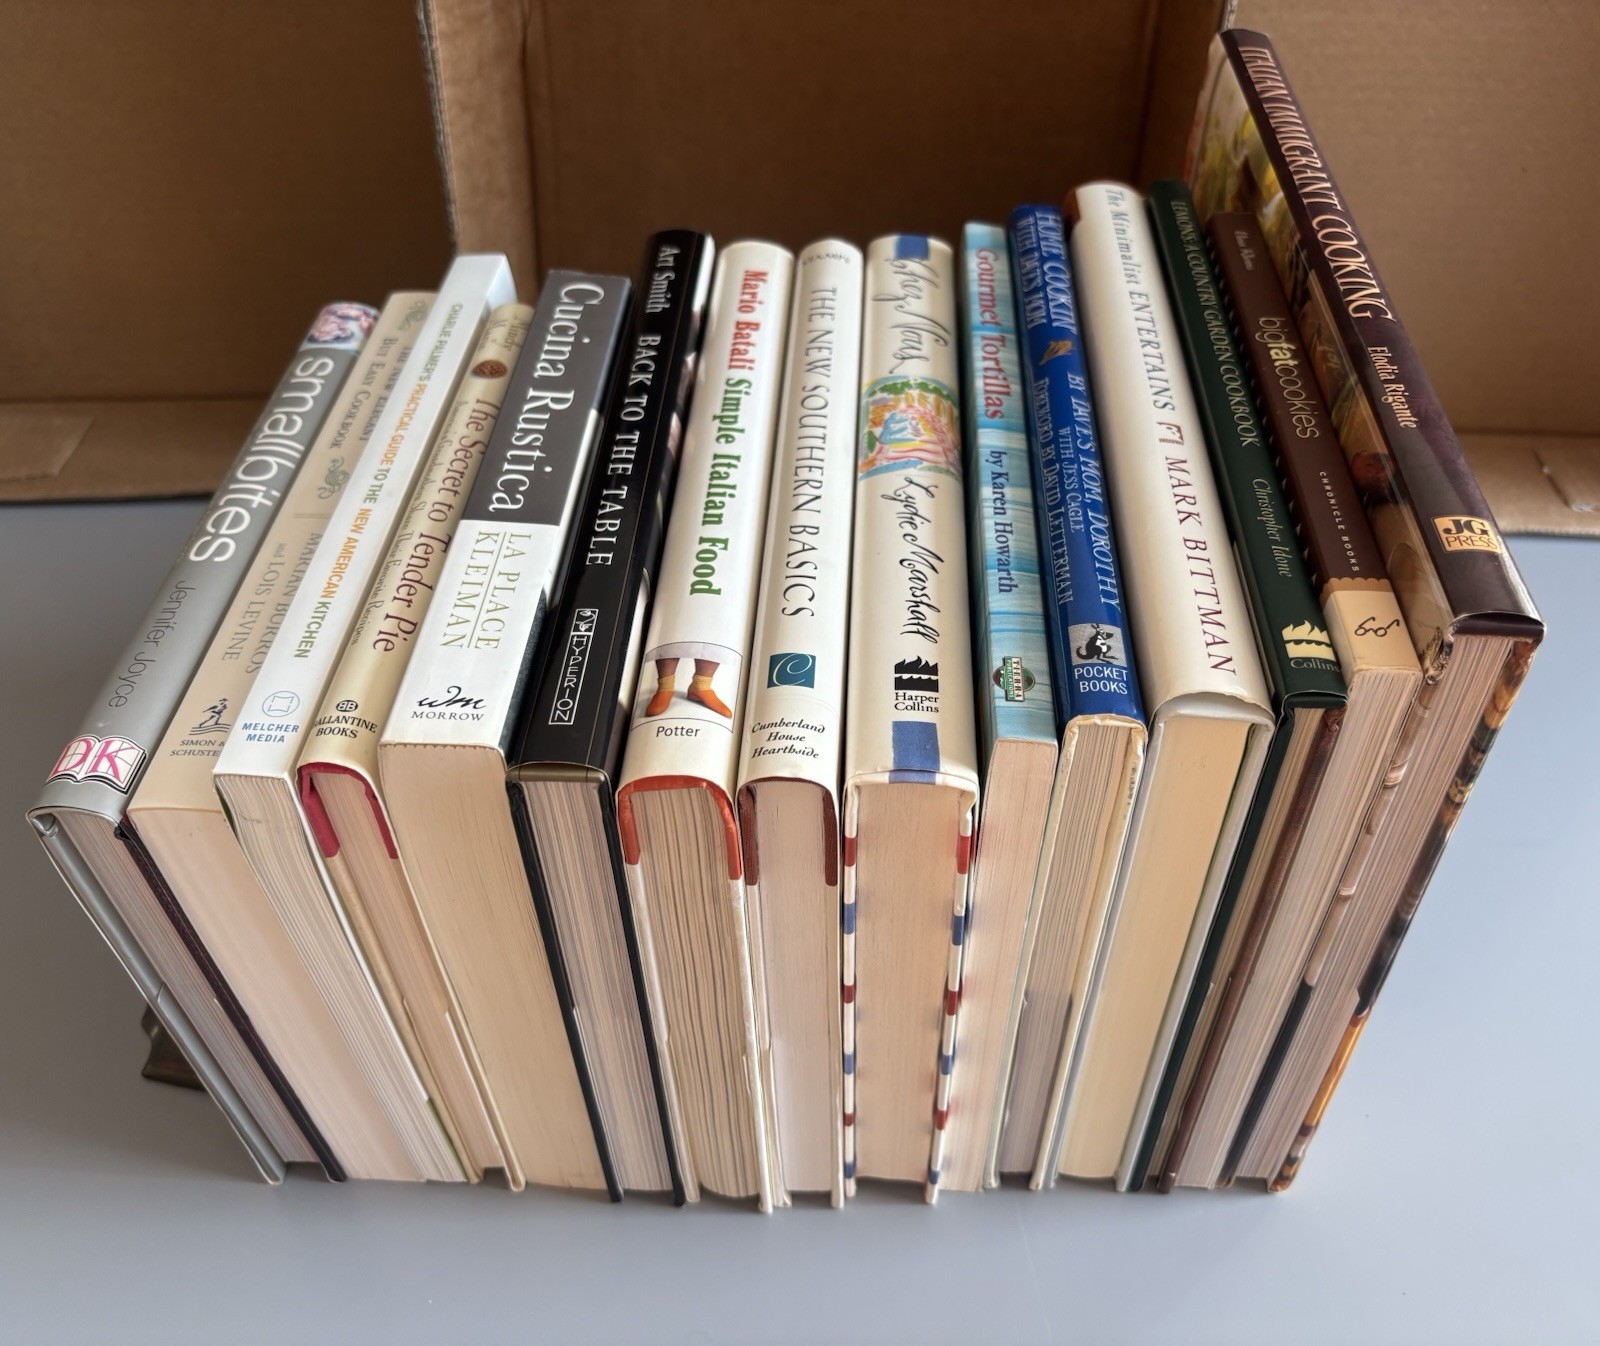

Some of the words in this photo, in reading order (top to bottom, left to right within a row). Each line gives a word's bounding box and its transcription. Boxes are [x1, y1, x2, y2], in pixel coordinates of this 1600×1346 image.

[1106, 188, 1125, 208] The
[656, 244, 681, 269] Art
[1035, 211, 1064, 259] HOME
[1110, 210, 1142, 286] Minimalist
[976, 247, 1001, 327] Gourmet
[1312, 214, 1397, 323] COOKING
[645, 271, 676, 314] Smith
[737, 269, 768, 314] Mario
[808, 287, 837, 321] THE
[439, 303, 464, 339] CHARLIE
[533, 283, 605, 379] Cucina
[419, 339, 448, 382] PALMER'S
[629, 334, 662, 387] BACK
[727, 320, 761, 371] Batali
[804, 330, 833, 378] NEW
[1128, 289, 1176, 411] ENTERTAINS
[1186, 251, 1217, 306] COUNTRY
[1204, 308, 1235, 364] GARDEN
[1220, 365, 1260, 447] COOKBOOK
[1367, 346, 1400, 381] Elodia
[980, 334, 1011, 419] Tortillas
[1067, 372, 1086, 395] BY
[1254, 317, 1319, 439] bigfatcookies
[395, 383, 428, 436] PRACTICAL
[466, 398, 501, 432] The
[620, 394, 648, 421] TO
[712, 377, 753, 445] Simple
[1381, 383, 1418, 430] Rigante
[188, 356, 335, 562] smallbites
[380, 435, 405, 466] GUIDE
[489, 387, 575, 512] Rustica
[607, 431, 639, 476] THE
[791, 385, 830, 512] SOUTHERN
[986, 450, 1008, 468] by
[1041, 444, 1056, 462] BY
[1059, 426, 1074, 459] WITH
[374, 467, 391, 482] TO
[438, 435, 488, 498] Secret
[1043, 463, 1061, 506] DAVID
[1062, 462, 1078, 490] JESS
[1079, 454, 1103, 503] MOM,
[364, 483, 384, 504] THE
[427, 501, 455, 523] to
[701, 453, 741, 526] Italian
[881, 477, 939, 530] Lydie
[990, 471, 1009, 517] Karen
[1165, 456, 1203, 526] MARK
[350, 508, 372, 534] NEW
[401, 501, 427, 530] Share
[586, 486, 629, 566] TABLE
[1066, 493, 1084, 533] CAGLE
[1252, 478, 1284, 542] Christopher
[1271, 542, 1292, 577] Idone
[1319, 471, 1345, 530] CHRONICLE
[1341, 535, 1360, 572] BOOKS
[1442, 518, 1490, 536] JG
[273, 543, 287, 559] and
[283, 533, 322, 597] MARIAN
[389, 530, 414, 561] Their
[503, 532, 532, 559] LA
[994, 521, 1018, 593] Howarth
[1048, 506, 1073, 605] LETTERMAN
[1087, 509, 1121, 613] DOROTHY
[1446, 535, 1498, 550] PRESS
[255, 561, 284, 596] LOIS
[321, 537, 360, 599] AMERICAN
[371, 559, 402, 599] Favorite
[392, 532, 452, 609] Tender
[689, 536, 729, 596] Food
[782, 525, 820, 616] BASICS
[899, 533, 944, 644] Marshall
[440, 531, 500, 649] KLEIMAN
[474, 570, 521, 649] PLACE
[1182, 536, 1237, 676] BITTMAN
[144, 580, 196, 647] Jennifer
[222, 601, 265, 661] LEVINE
[294, 602, 331, 658] KITCHEN
[351, 600, 384, 646] Recipes
[373, 613, 418, 652] Pie
[246, 602, 290, 674] BURROS
[108, 651, 157, 707] Joyce
[554, 636, 588, 721] HYPERION
[1074, 667, 1128, 681] POCKET
[1080, 681, 1128, 694] BOOKS
[1290, 659, 1340, 672] Collins
[411, 711, 484, 721] MORROW
[894, 692, 939, 704] Harper
[894, 702, 939, 713] Collins
[241, 722, 300, 733] MELCHER
[246, 733, 285, 743] MEDIA
[316, 727, 358, 738] BOOKS
[656, 725, 700, 738] Potter
[752, 717, 826, 734] Cumberland
[766, 731, 806, 742] House
[50, 740, 136, 784] DK
[170, 749, 221, 757] SCHUSTE
[751, 744, 820, 759] Hearthside
